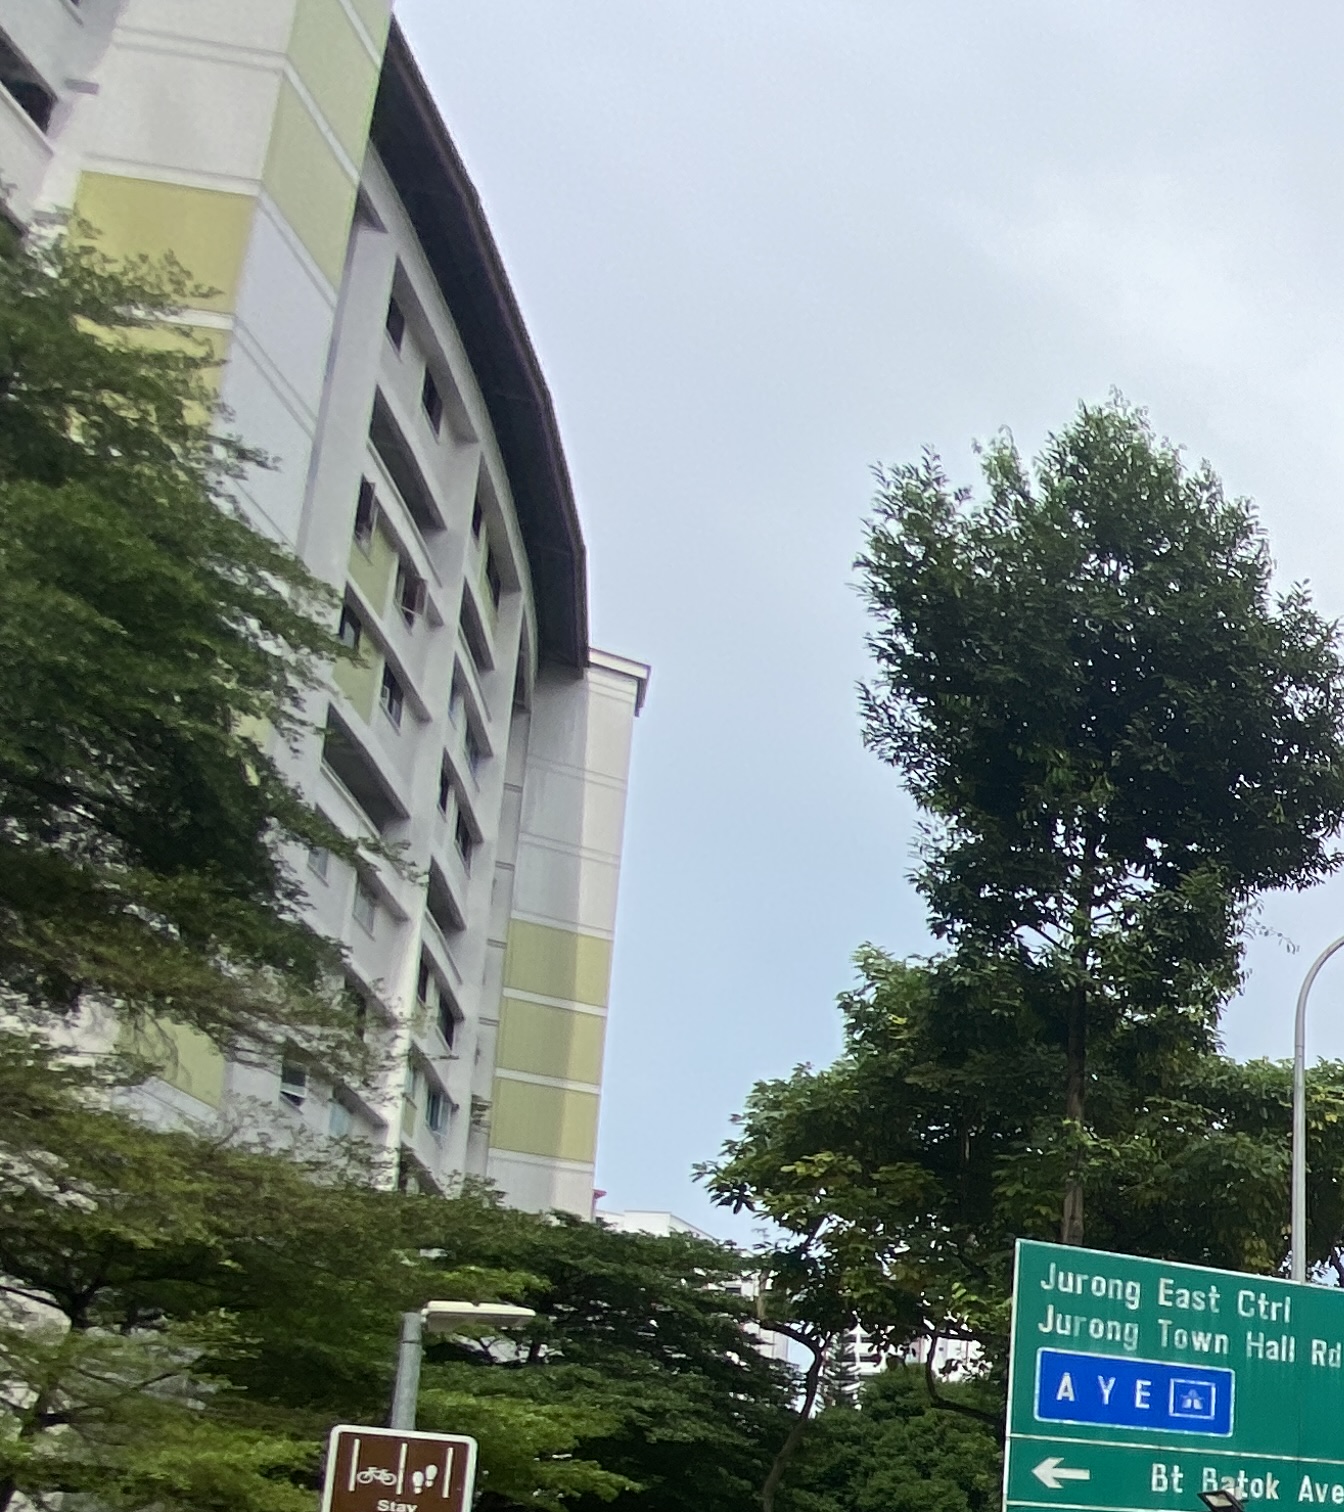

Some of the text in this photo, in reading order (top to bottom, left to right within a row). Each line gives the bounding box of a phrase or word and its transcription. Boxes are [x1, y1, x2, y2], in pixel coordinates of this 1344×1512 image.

[1040, 1262, 1292, 1323] Jurong East Ctrl
[1038, 1304, 1343, 1369] Jurong Town Hall Rd
[1152, 1463, 1184, 1494] Bt
[1202, 1467, 1280, 1500] Batok
